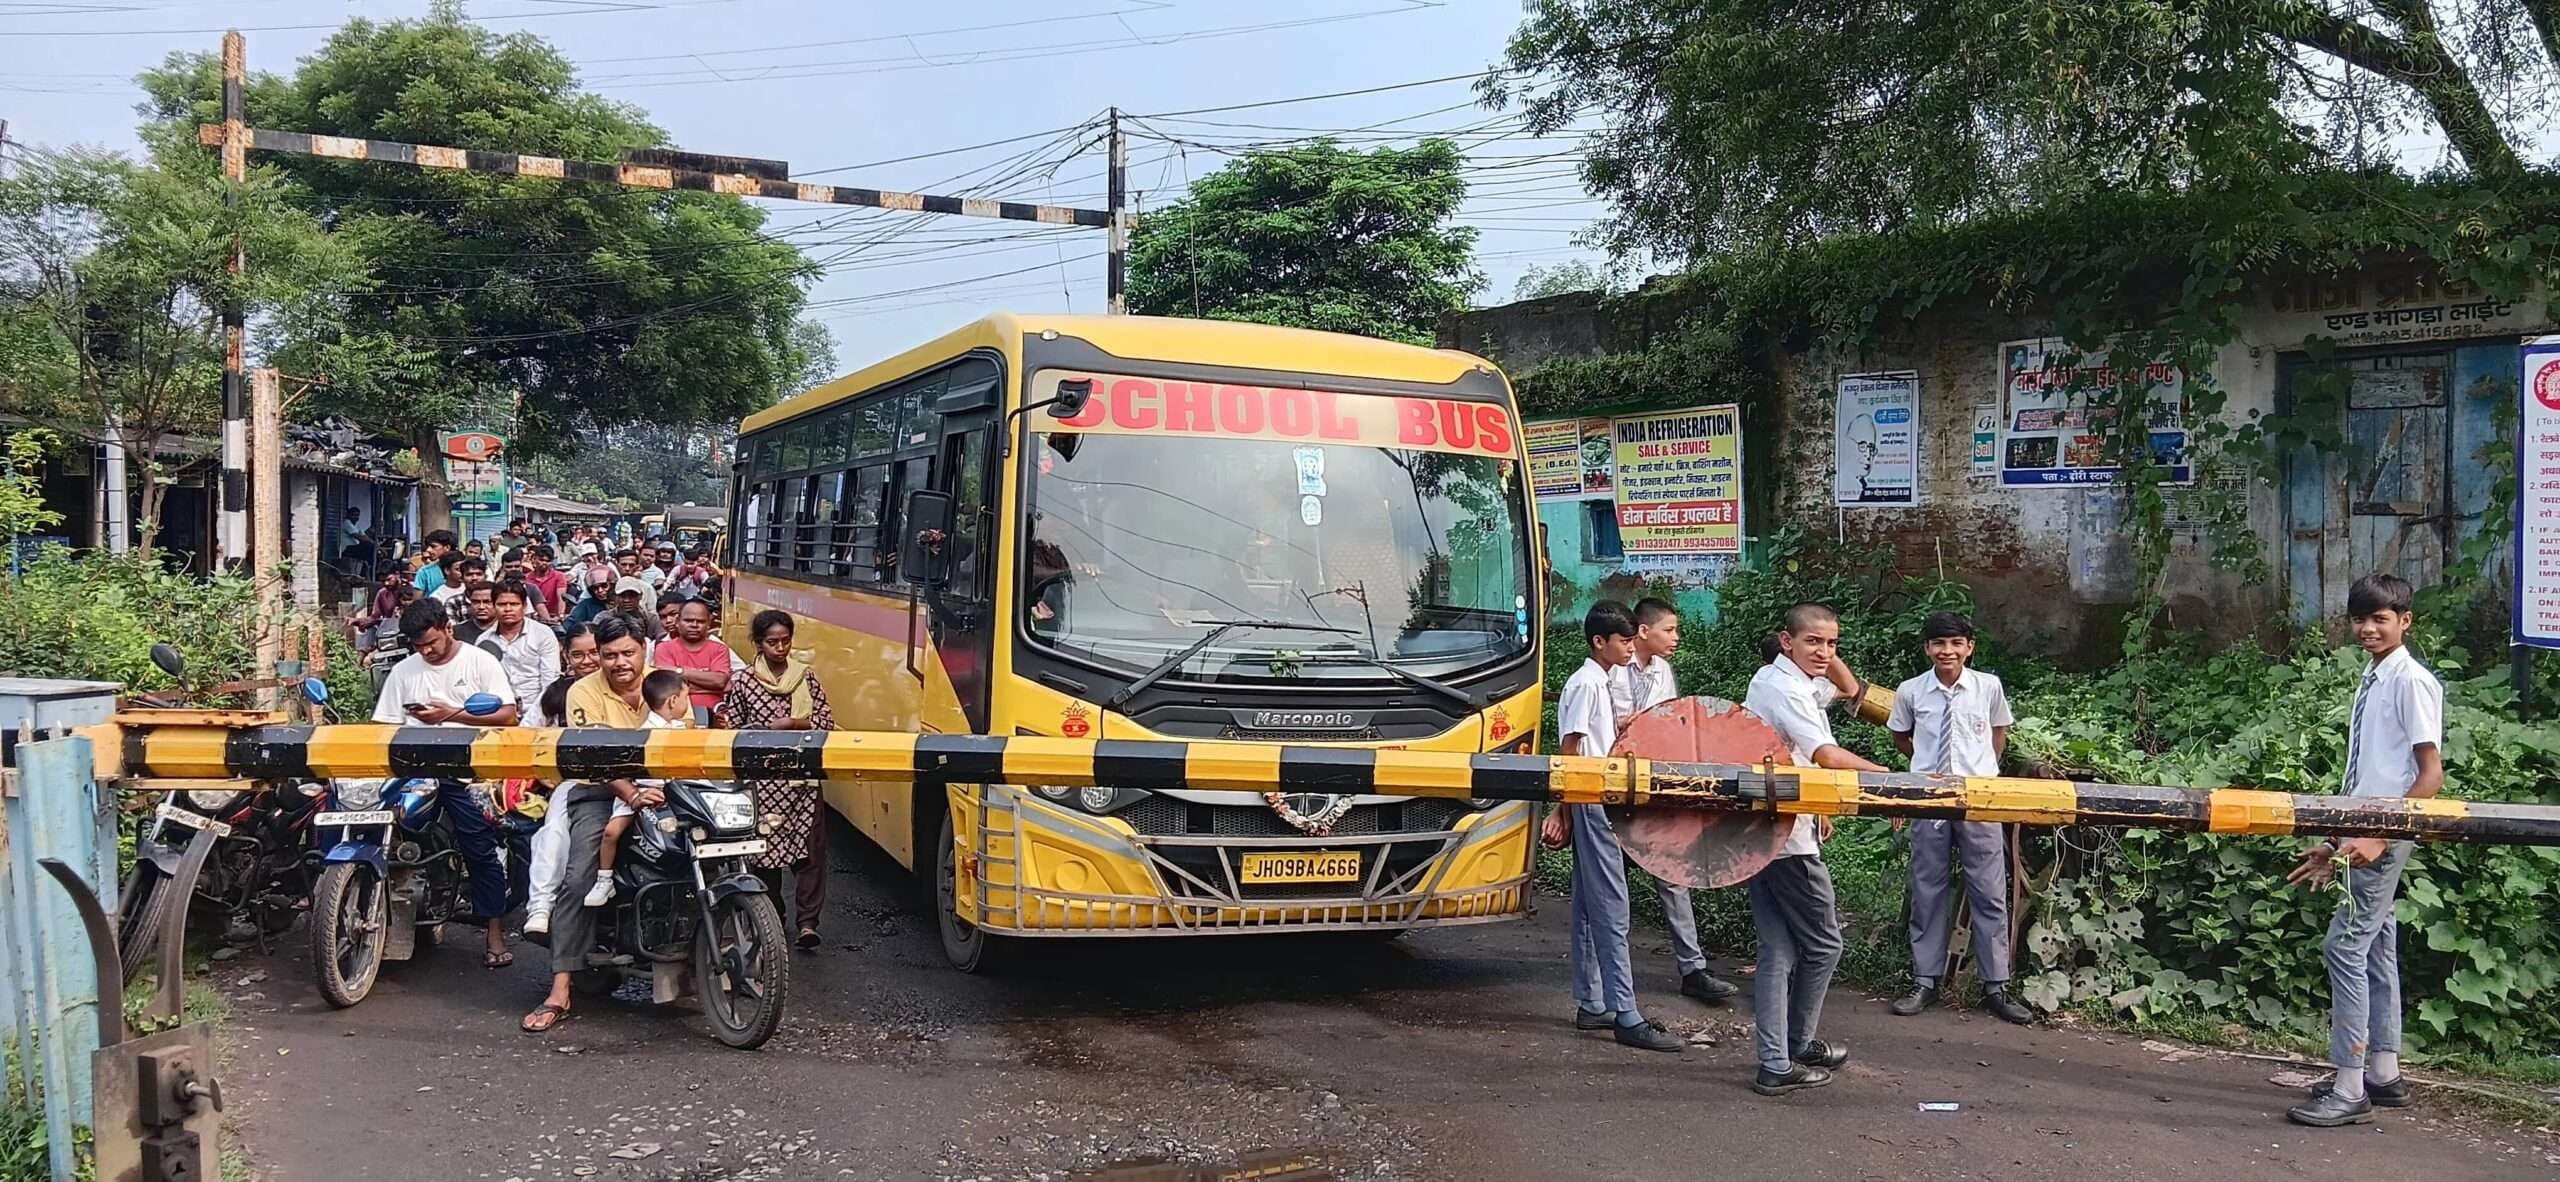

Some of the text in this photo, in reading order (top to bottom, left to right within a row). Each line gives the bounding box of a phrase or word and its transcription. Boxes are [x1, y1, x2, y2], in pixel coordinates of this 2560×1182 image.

[1055, 378, 1512, 453] SCHOOL BUS
[1617, 421, 1646, 443] INDIA
[1648, 413, 1733, 440] REFRIGERATION
[1638, 440, 1711, 457] SALE & SERVICE
[1622, 502, 1733, 525] होम सर्विस उपलब्ध है
[1684, 536, 1736, 547] 9934357086
[572, 708, 587, 726] 3
[1253, 711, 1352, 727] Marcopolo
[1252, 857, 1358, 878] JH09BA4666
